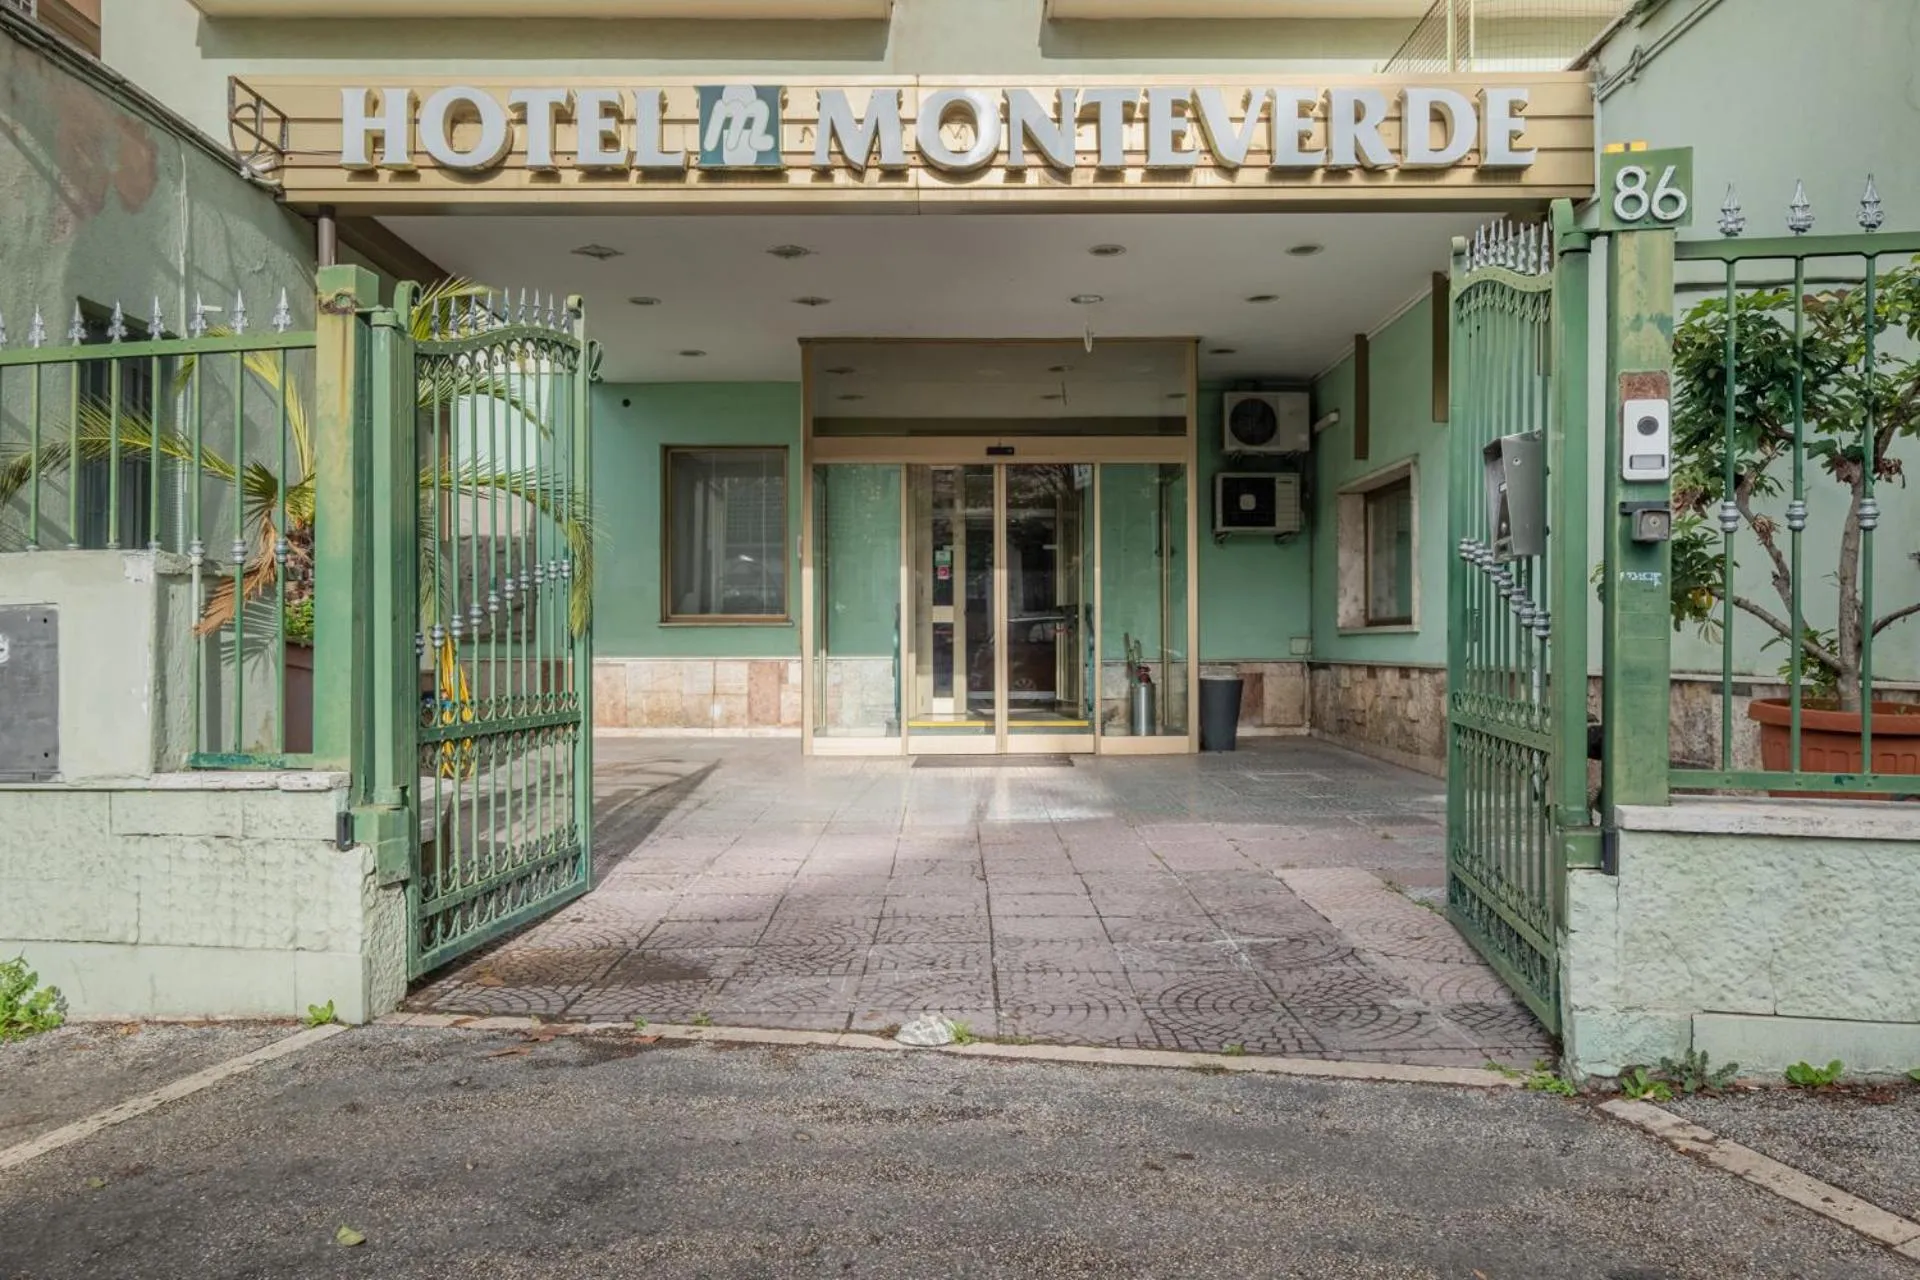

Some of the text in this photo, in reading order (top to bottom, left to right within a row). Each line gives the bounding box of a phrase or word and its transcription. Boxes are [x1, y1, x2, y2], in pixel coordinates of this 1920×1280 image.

[340, 86, 689, 170] HOTEL
[812, 87, 1537, 170] MONTEVERDE
[1613, 165, 1688, 222] 86
